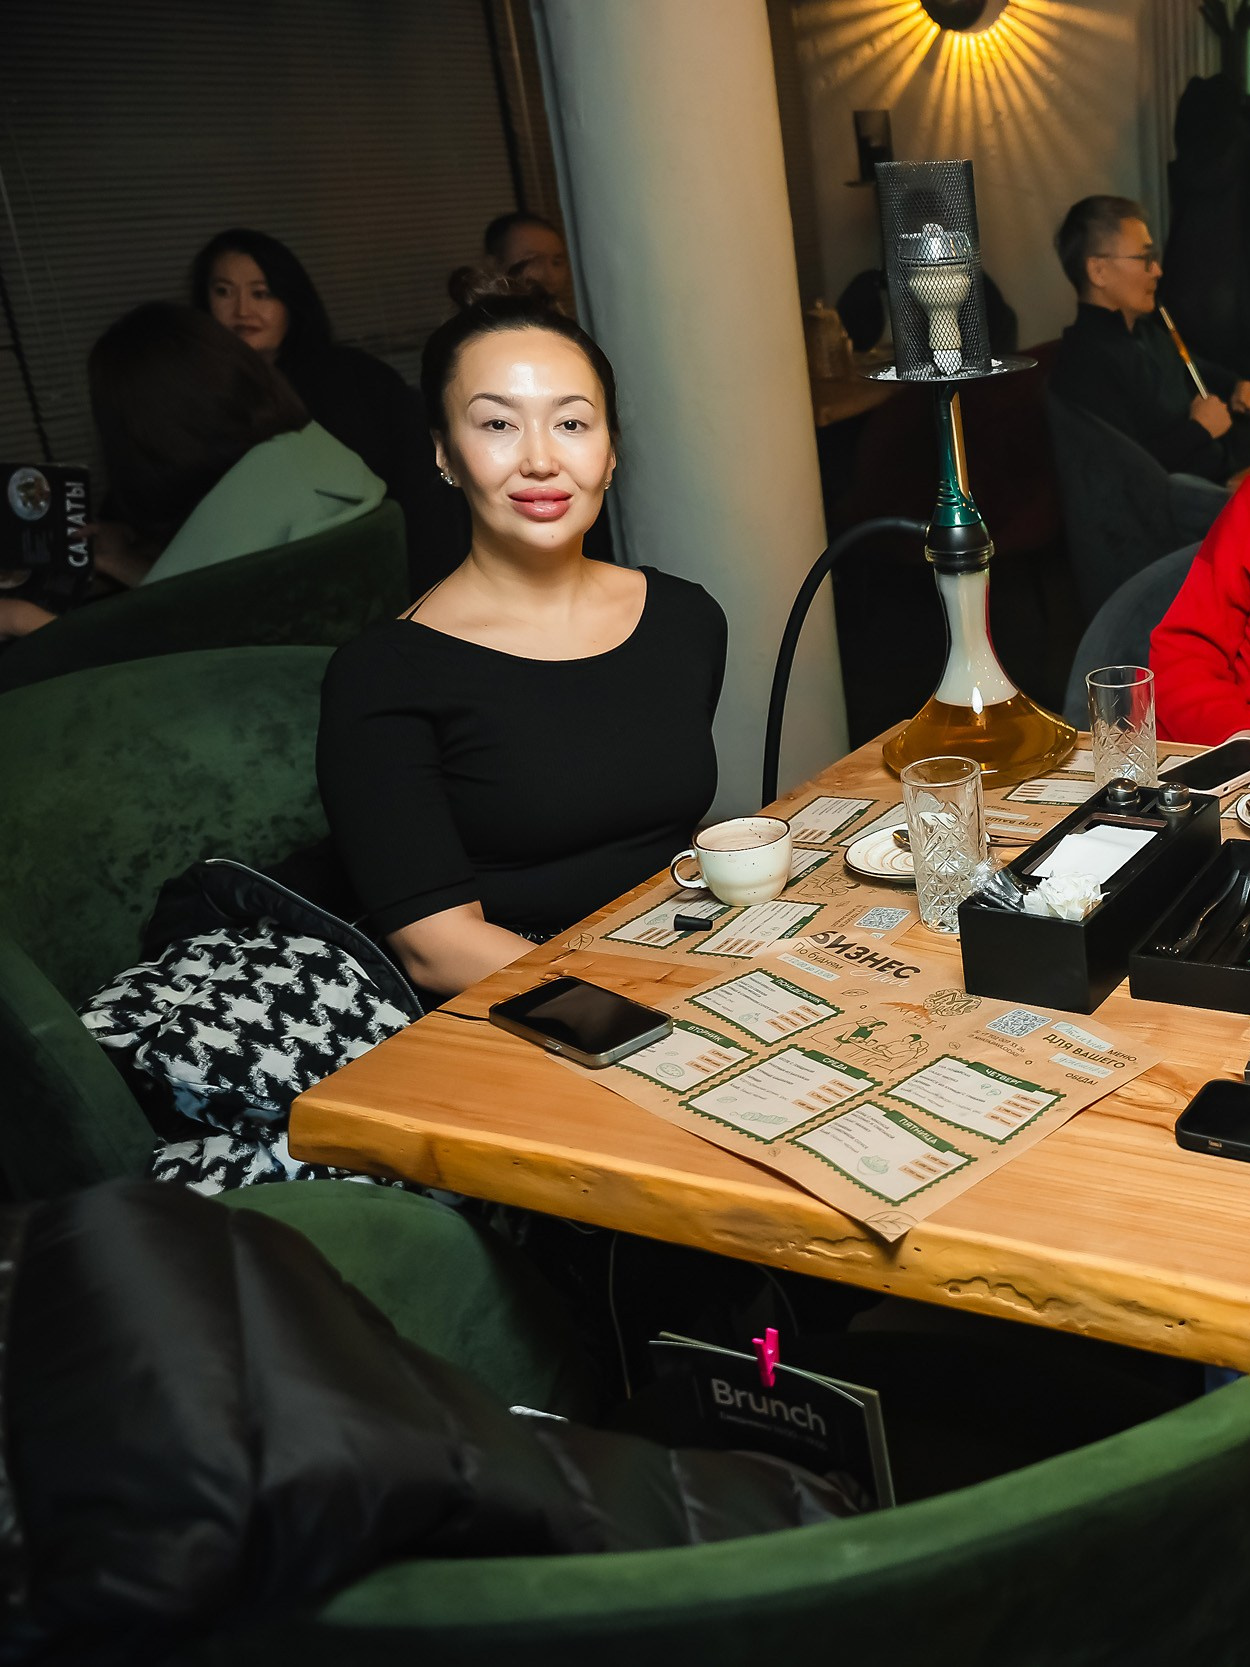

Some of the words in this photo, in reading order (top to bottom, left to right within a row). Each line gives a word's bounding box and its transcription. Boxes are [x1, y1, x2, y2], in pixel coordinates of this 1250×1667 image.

[810, 930, 921, 979] БИЗНЕС
[687, 1025, 724, 1042] ВТОРНИК
[822, 1056, 849, 1072] СРЕДА
[1043, 1033, 1073, 1051] ДЛЯ
[1072, 1047, 1125, 1070] ВАШЕГО
[985, 1067, 1024, 1086] ЧЕТВЕРГ
[898, 1117, 939, 1146] ПЯТНИЦА
[711, 1378, 827, 1437] Brunch
